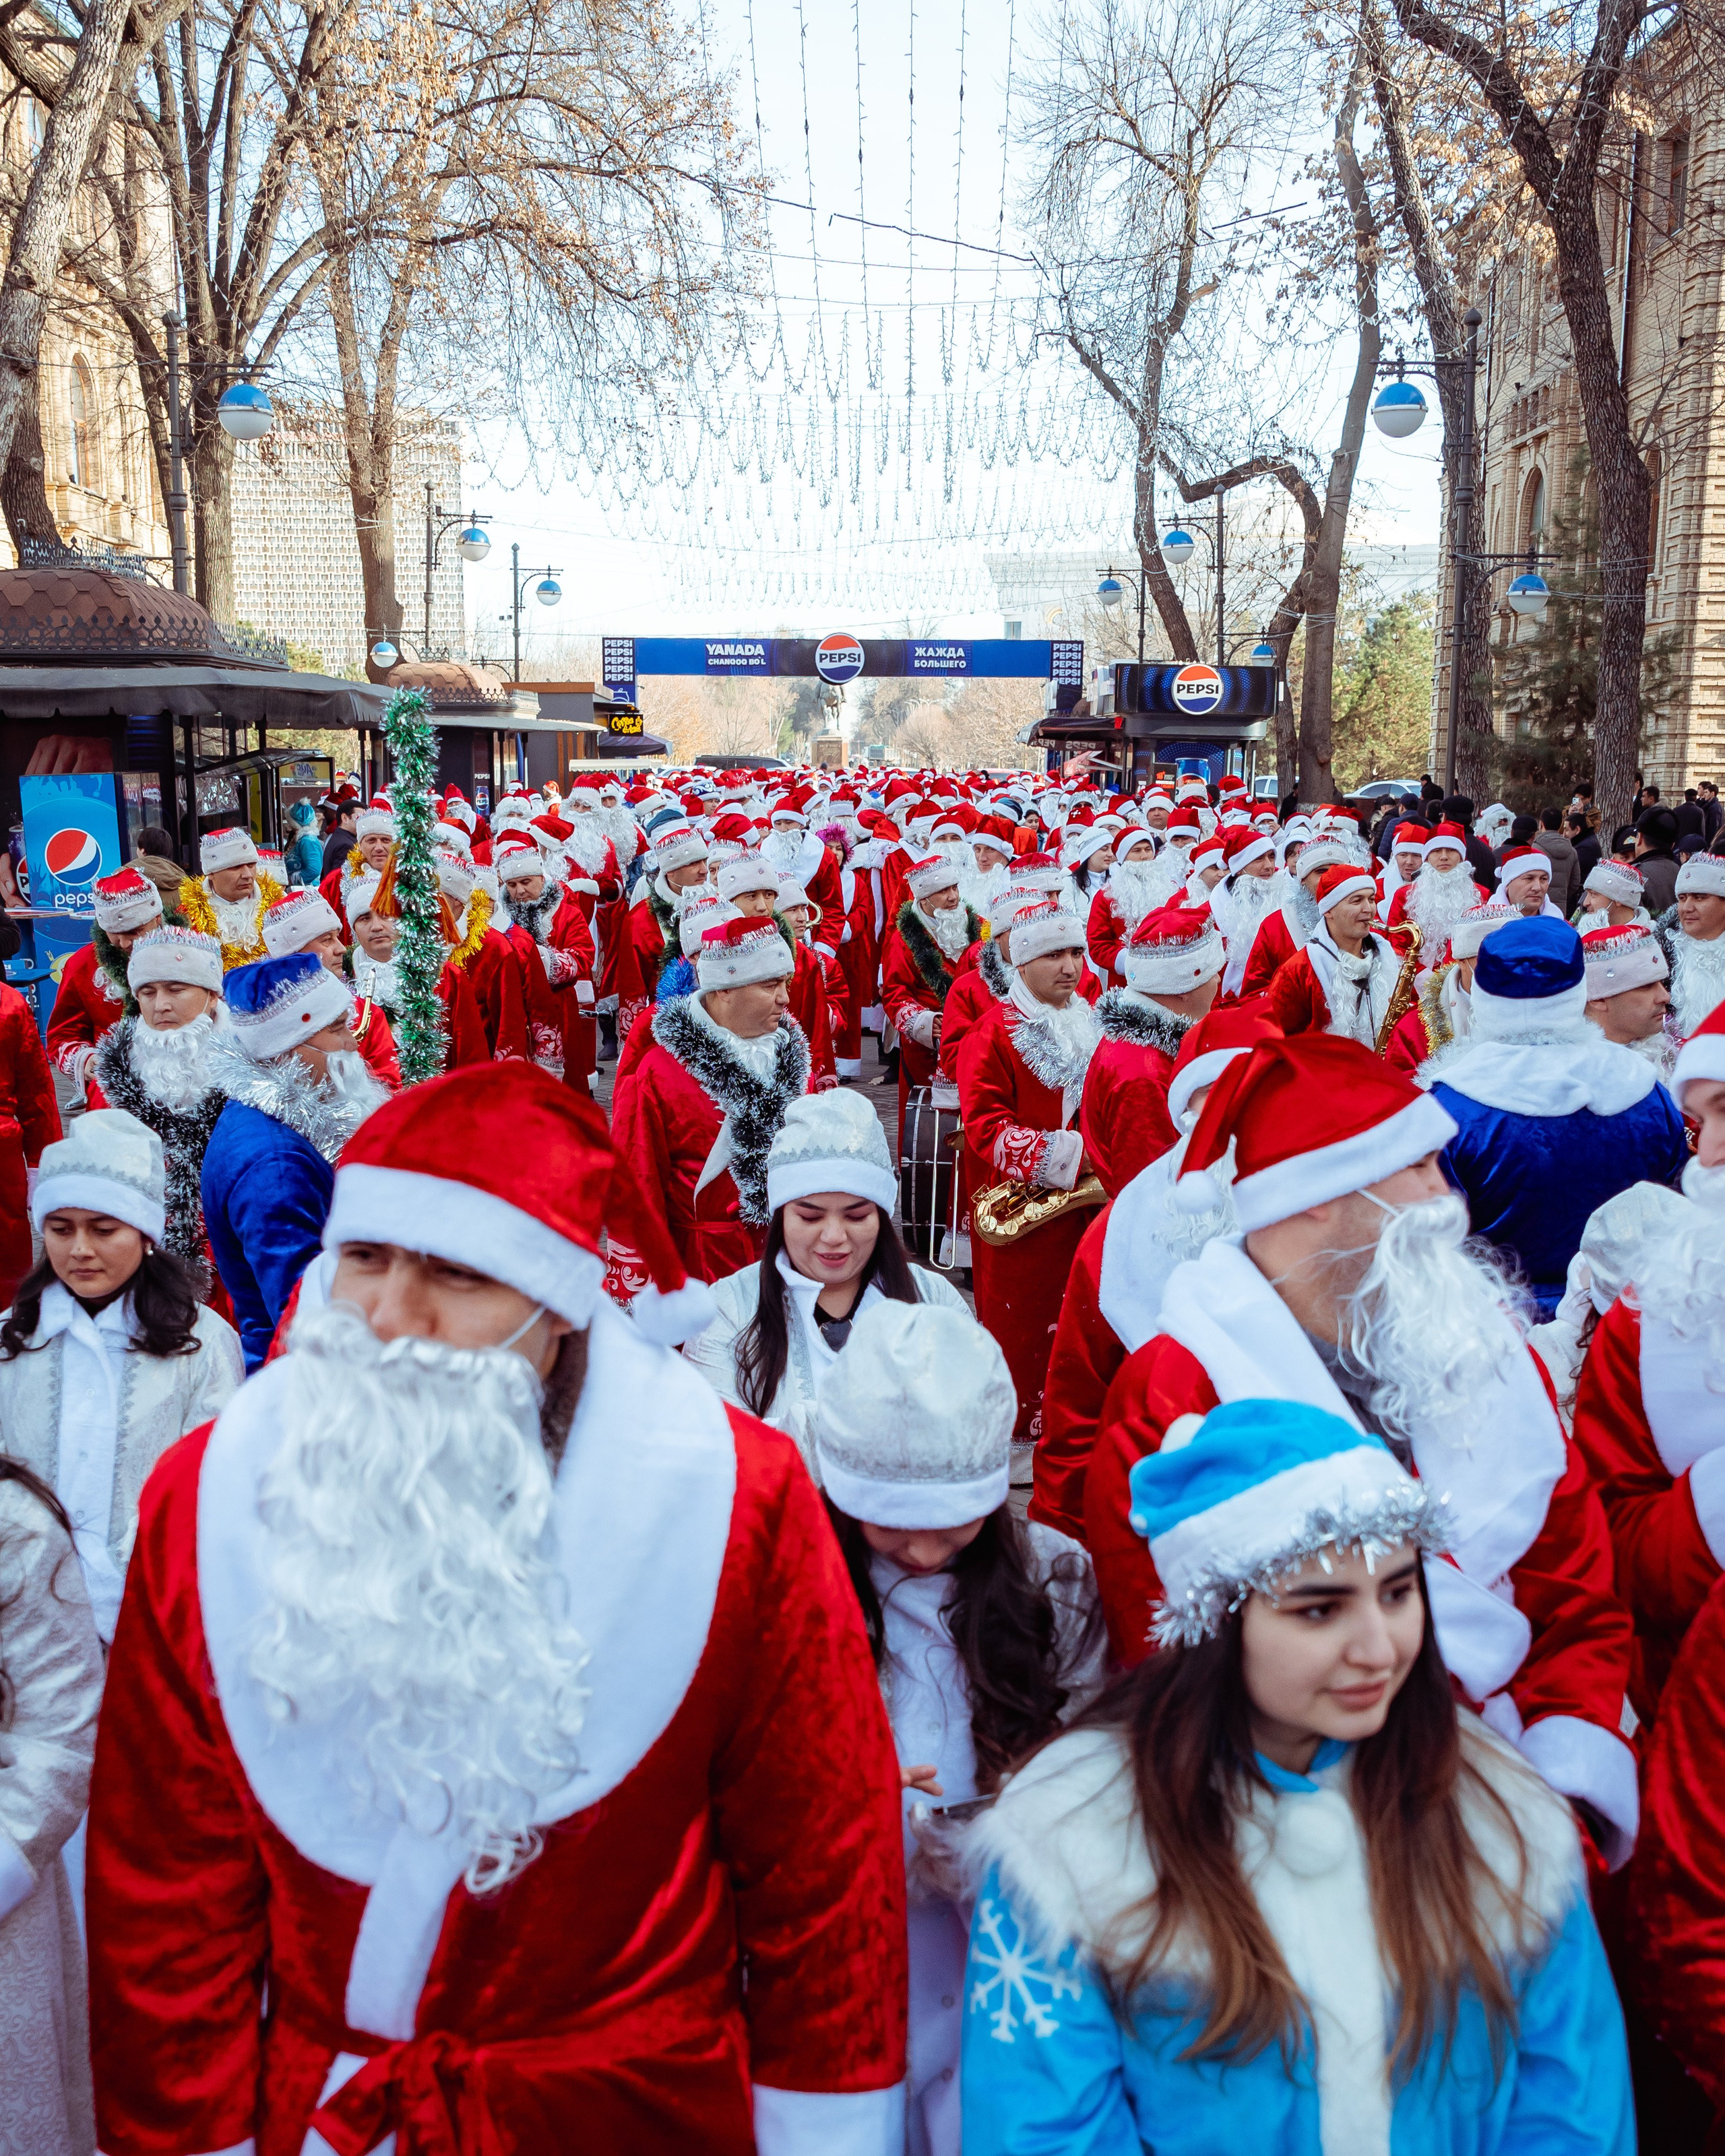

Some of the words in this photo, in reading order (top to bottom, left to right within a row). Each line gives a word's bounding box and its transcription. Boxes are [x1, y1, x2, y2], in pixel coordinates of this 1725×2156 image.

[604, 639, 633, 647] PEPSI
[705, 645, 765, 656] YANADA
[914, 647, 965, 659] ЖАЖДА
[605, 656, 633, 664] PEPSI
[819, 653, 861, 663] PEPSI
[1053, 652, 1081, 660] PEPSI
[914, 660, 966, 668] БОЛЬШЕГО
[1053, 660, 1081, 668] PEPSI
[605, 665, 633, 673] PEPSI
[1177, 684, 1220, 694] PEPSI
[55, 893, 94, 908] peps
